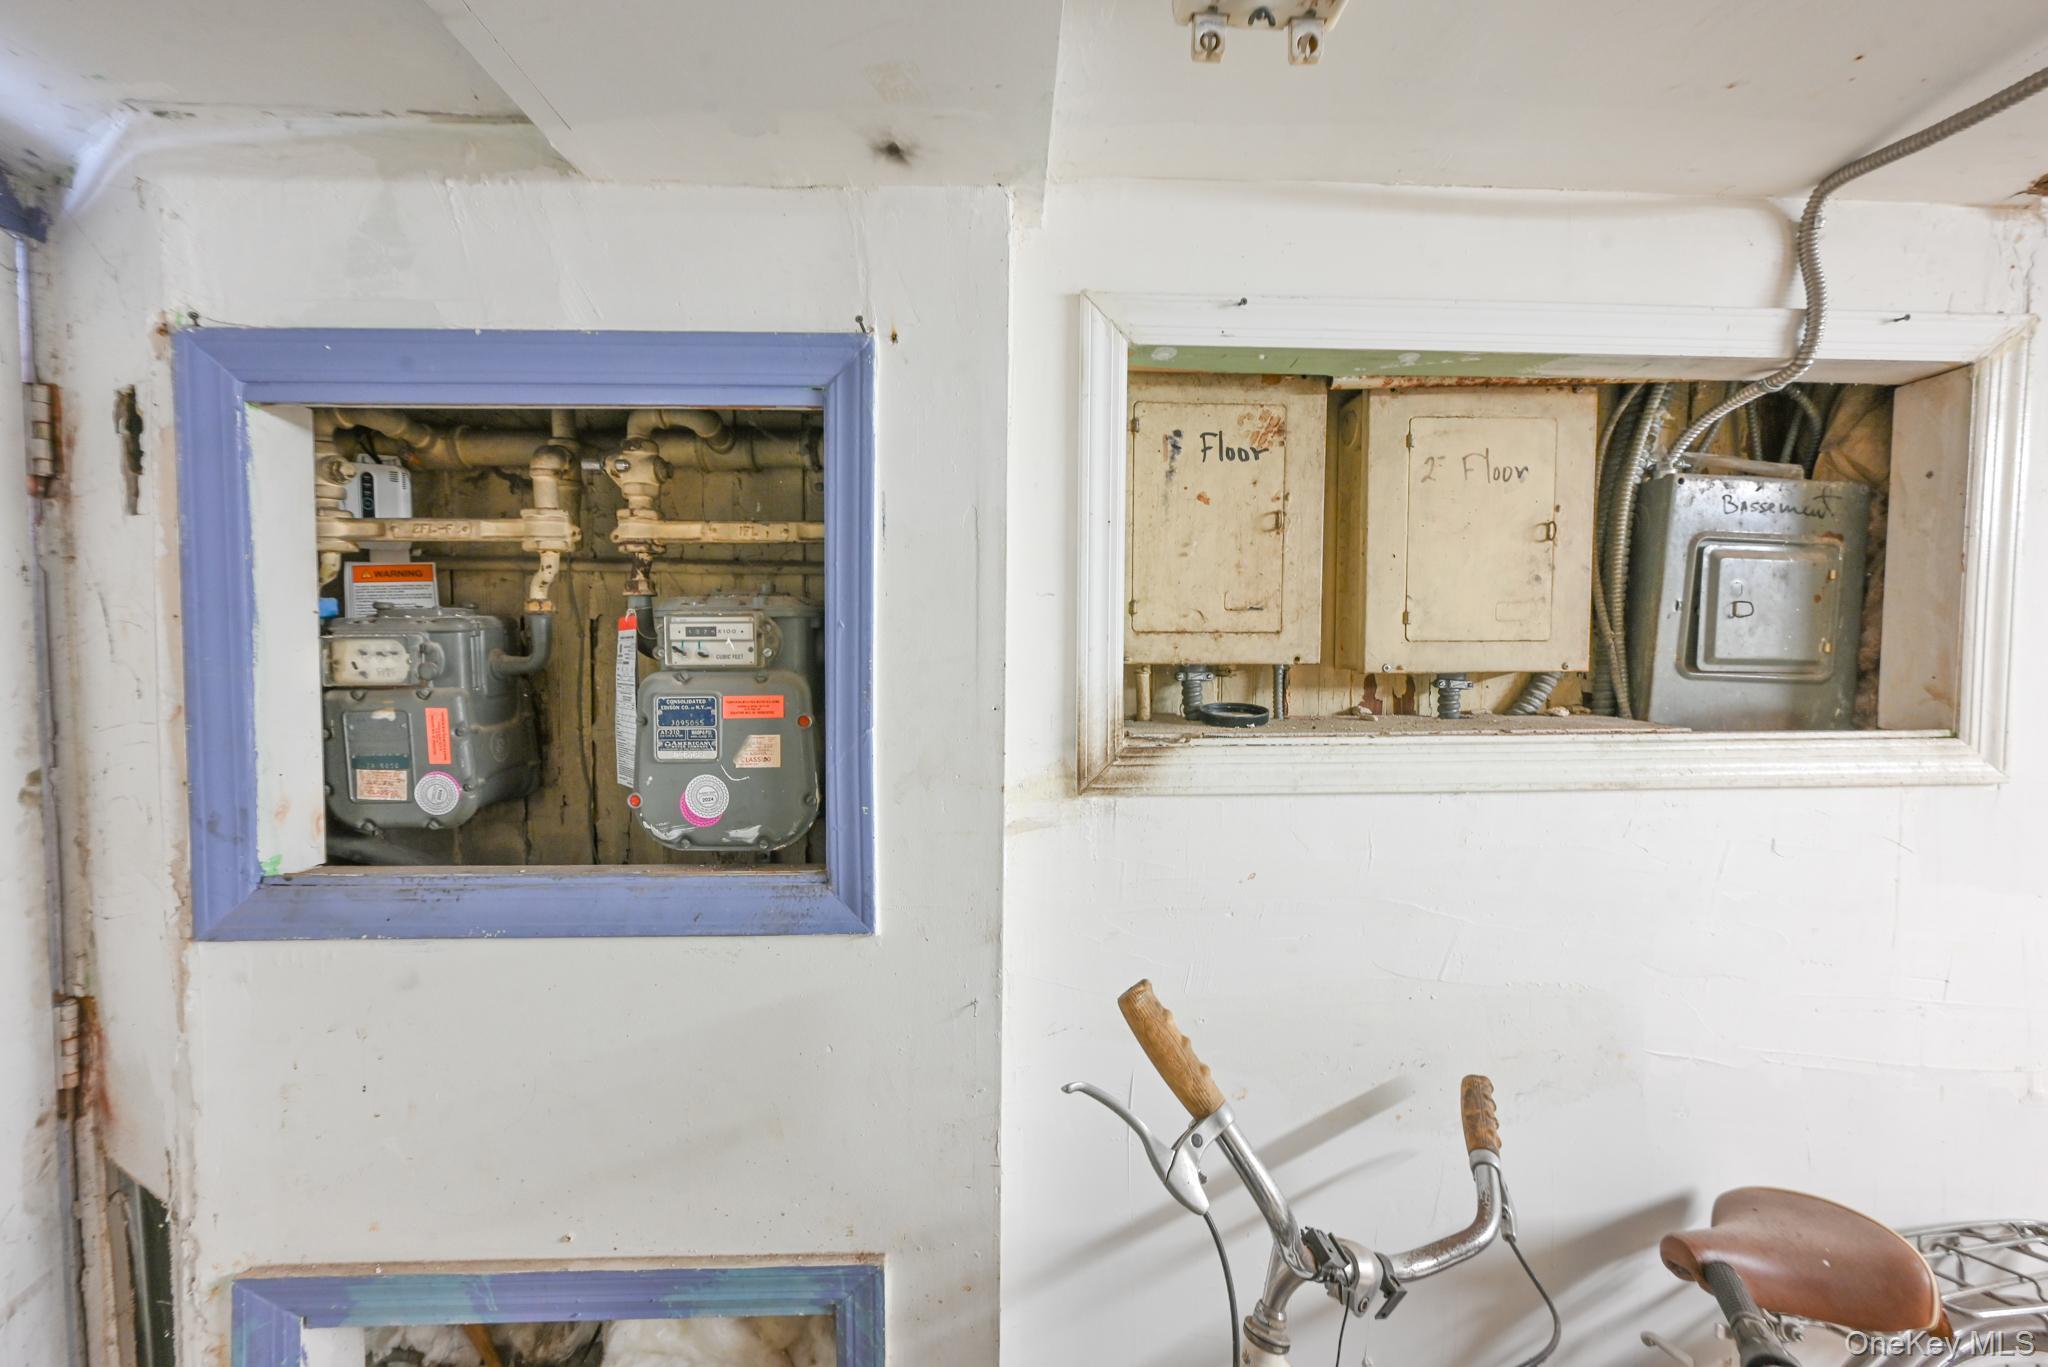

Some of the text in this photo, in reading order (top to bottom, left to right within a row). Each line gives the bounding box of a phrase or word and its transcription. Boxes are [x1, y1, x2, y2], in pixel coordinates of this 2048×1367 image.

[1200, 430, 1269, 462] Floor
[1462, 447, 1529, 483] Floor
[373, 569, 423, 578] WARNING
